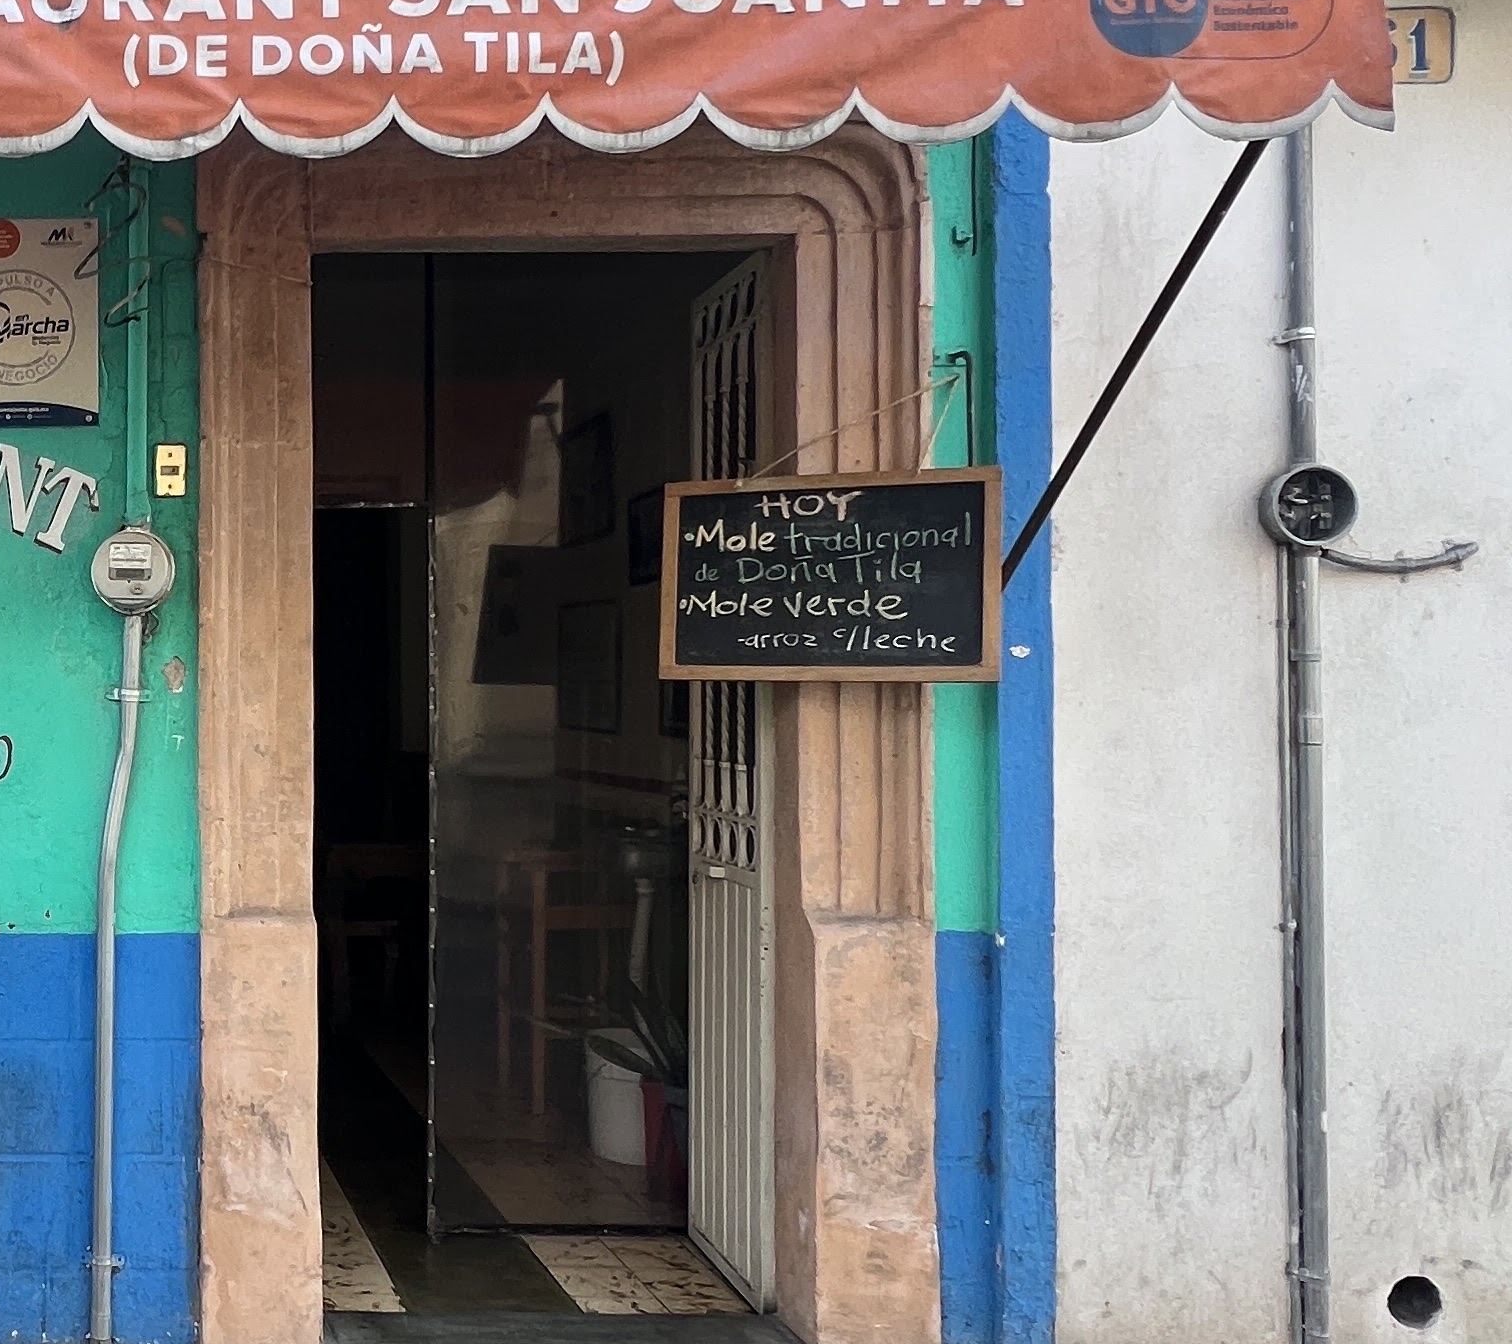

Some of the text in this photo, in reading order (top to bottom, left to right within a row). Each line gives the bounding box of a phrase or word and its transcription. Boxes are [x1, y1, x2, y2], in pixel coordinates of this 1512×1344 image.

[124, 22, 625, 89] (DE DOÑA TILA)
[753, 489, 864, 522] HOY
[783, 511, 972, 556] tradicional
[694, 562, 720, 583] de
[838, 551, 923, 584] Tila
